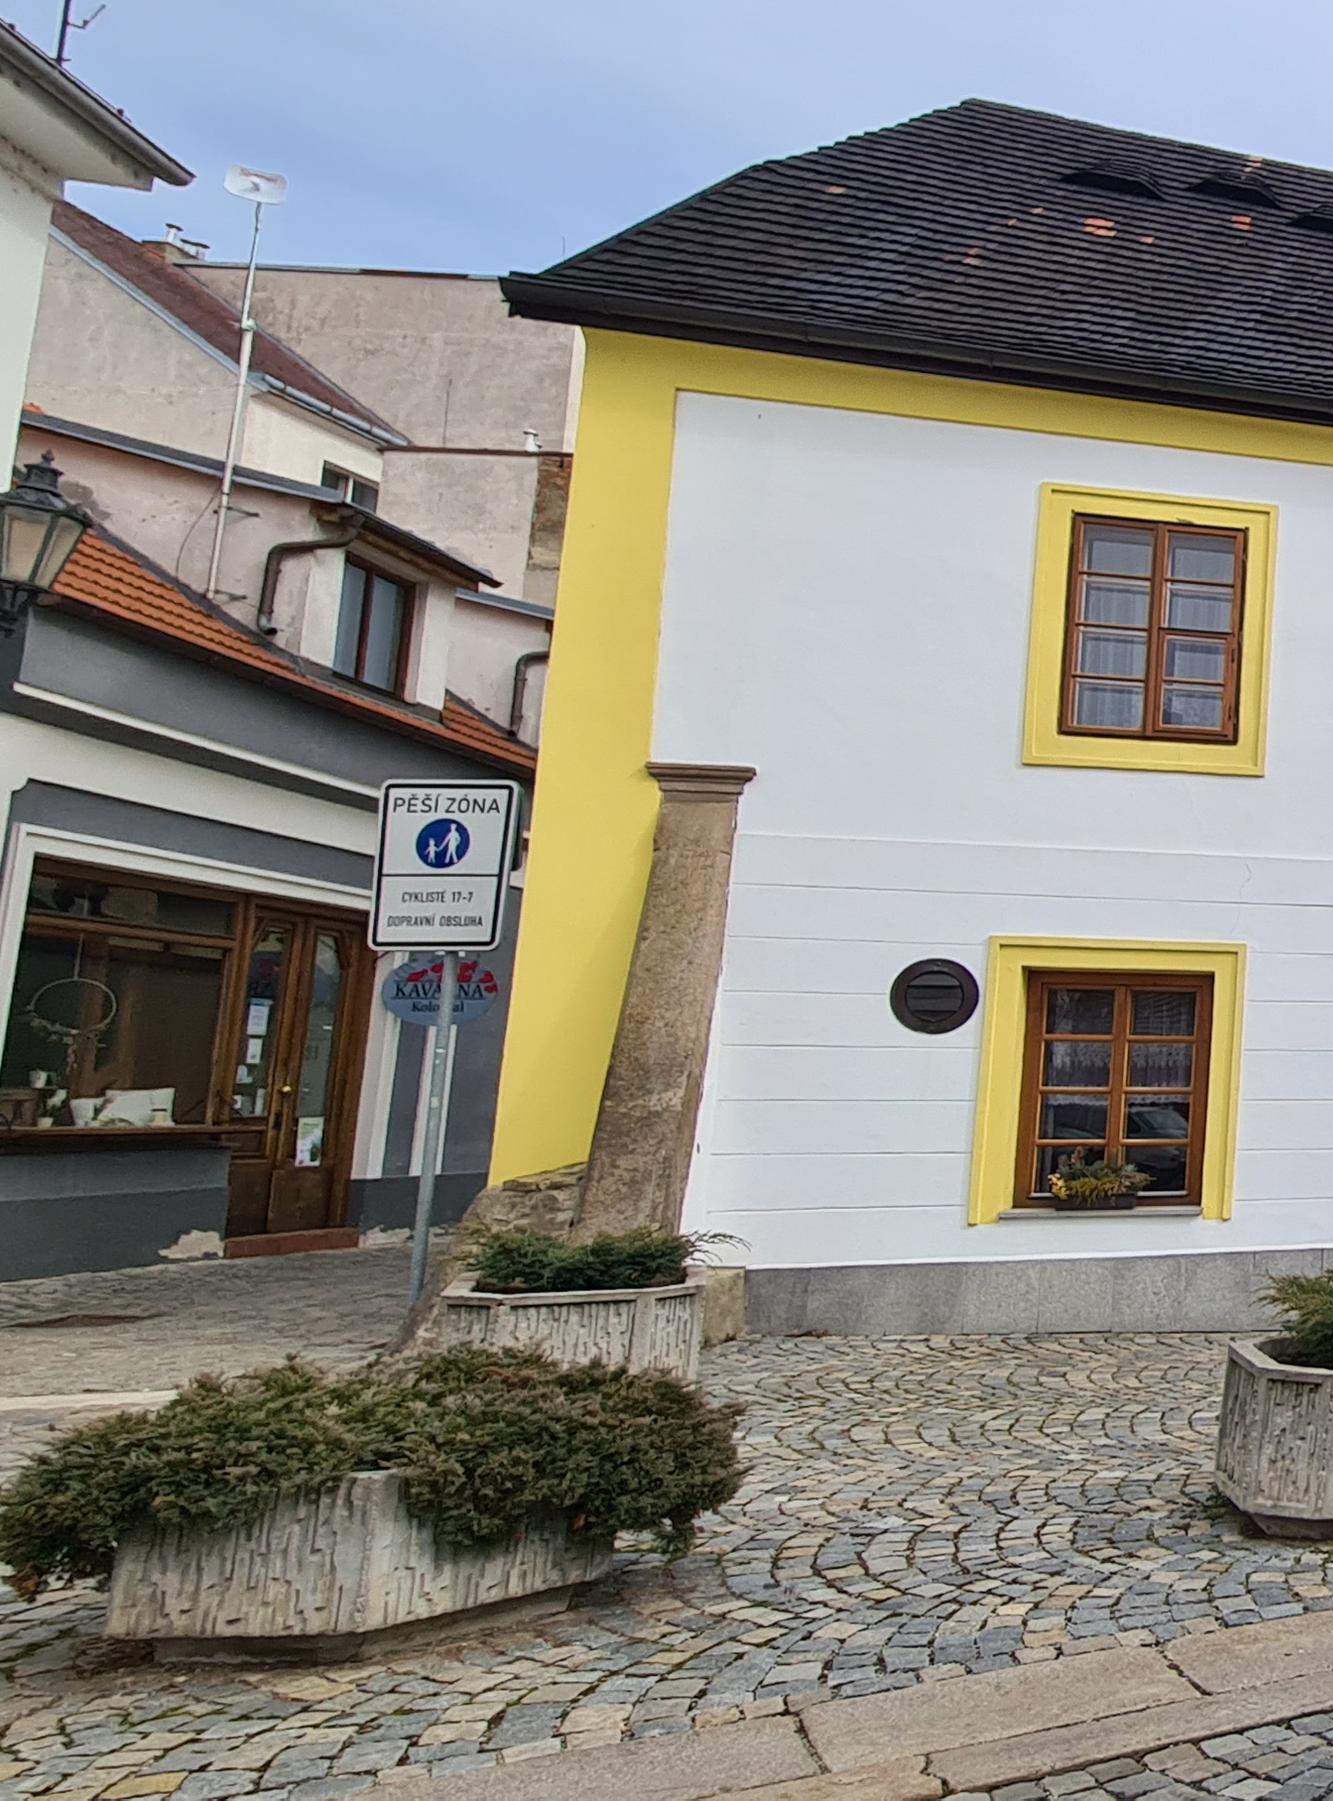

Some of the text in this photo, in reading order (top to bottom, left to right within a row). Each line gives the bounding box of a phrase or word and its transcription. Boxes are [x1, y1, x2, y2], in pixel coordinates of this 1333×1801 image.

[393, 793, 500, 813] PĚŠÍ ZÓNA
[401, 890, 475, 904] CYKLISTÉ 17-7
[387, 913, 483, 927] DOPRAVNÍ OBSLUHA
